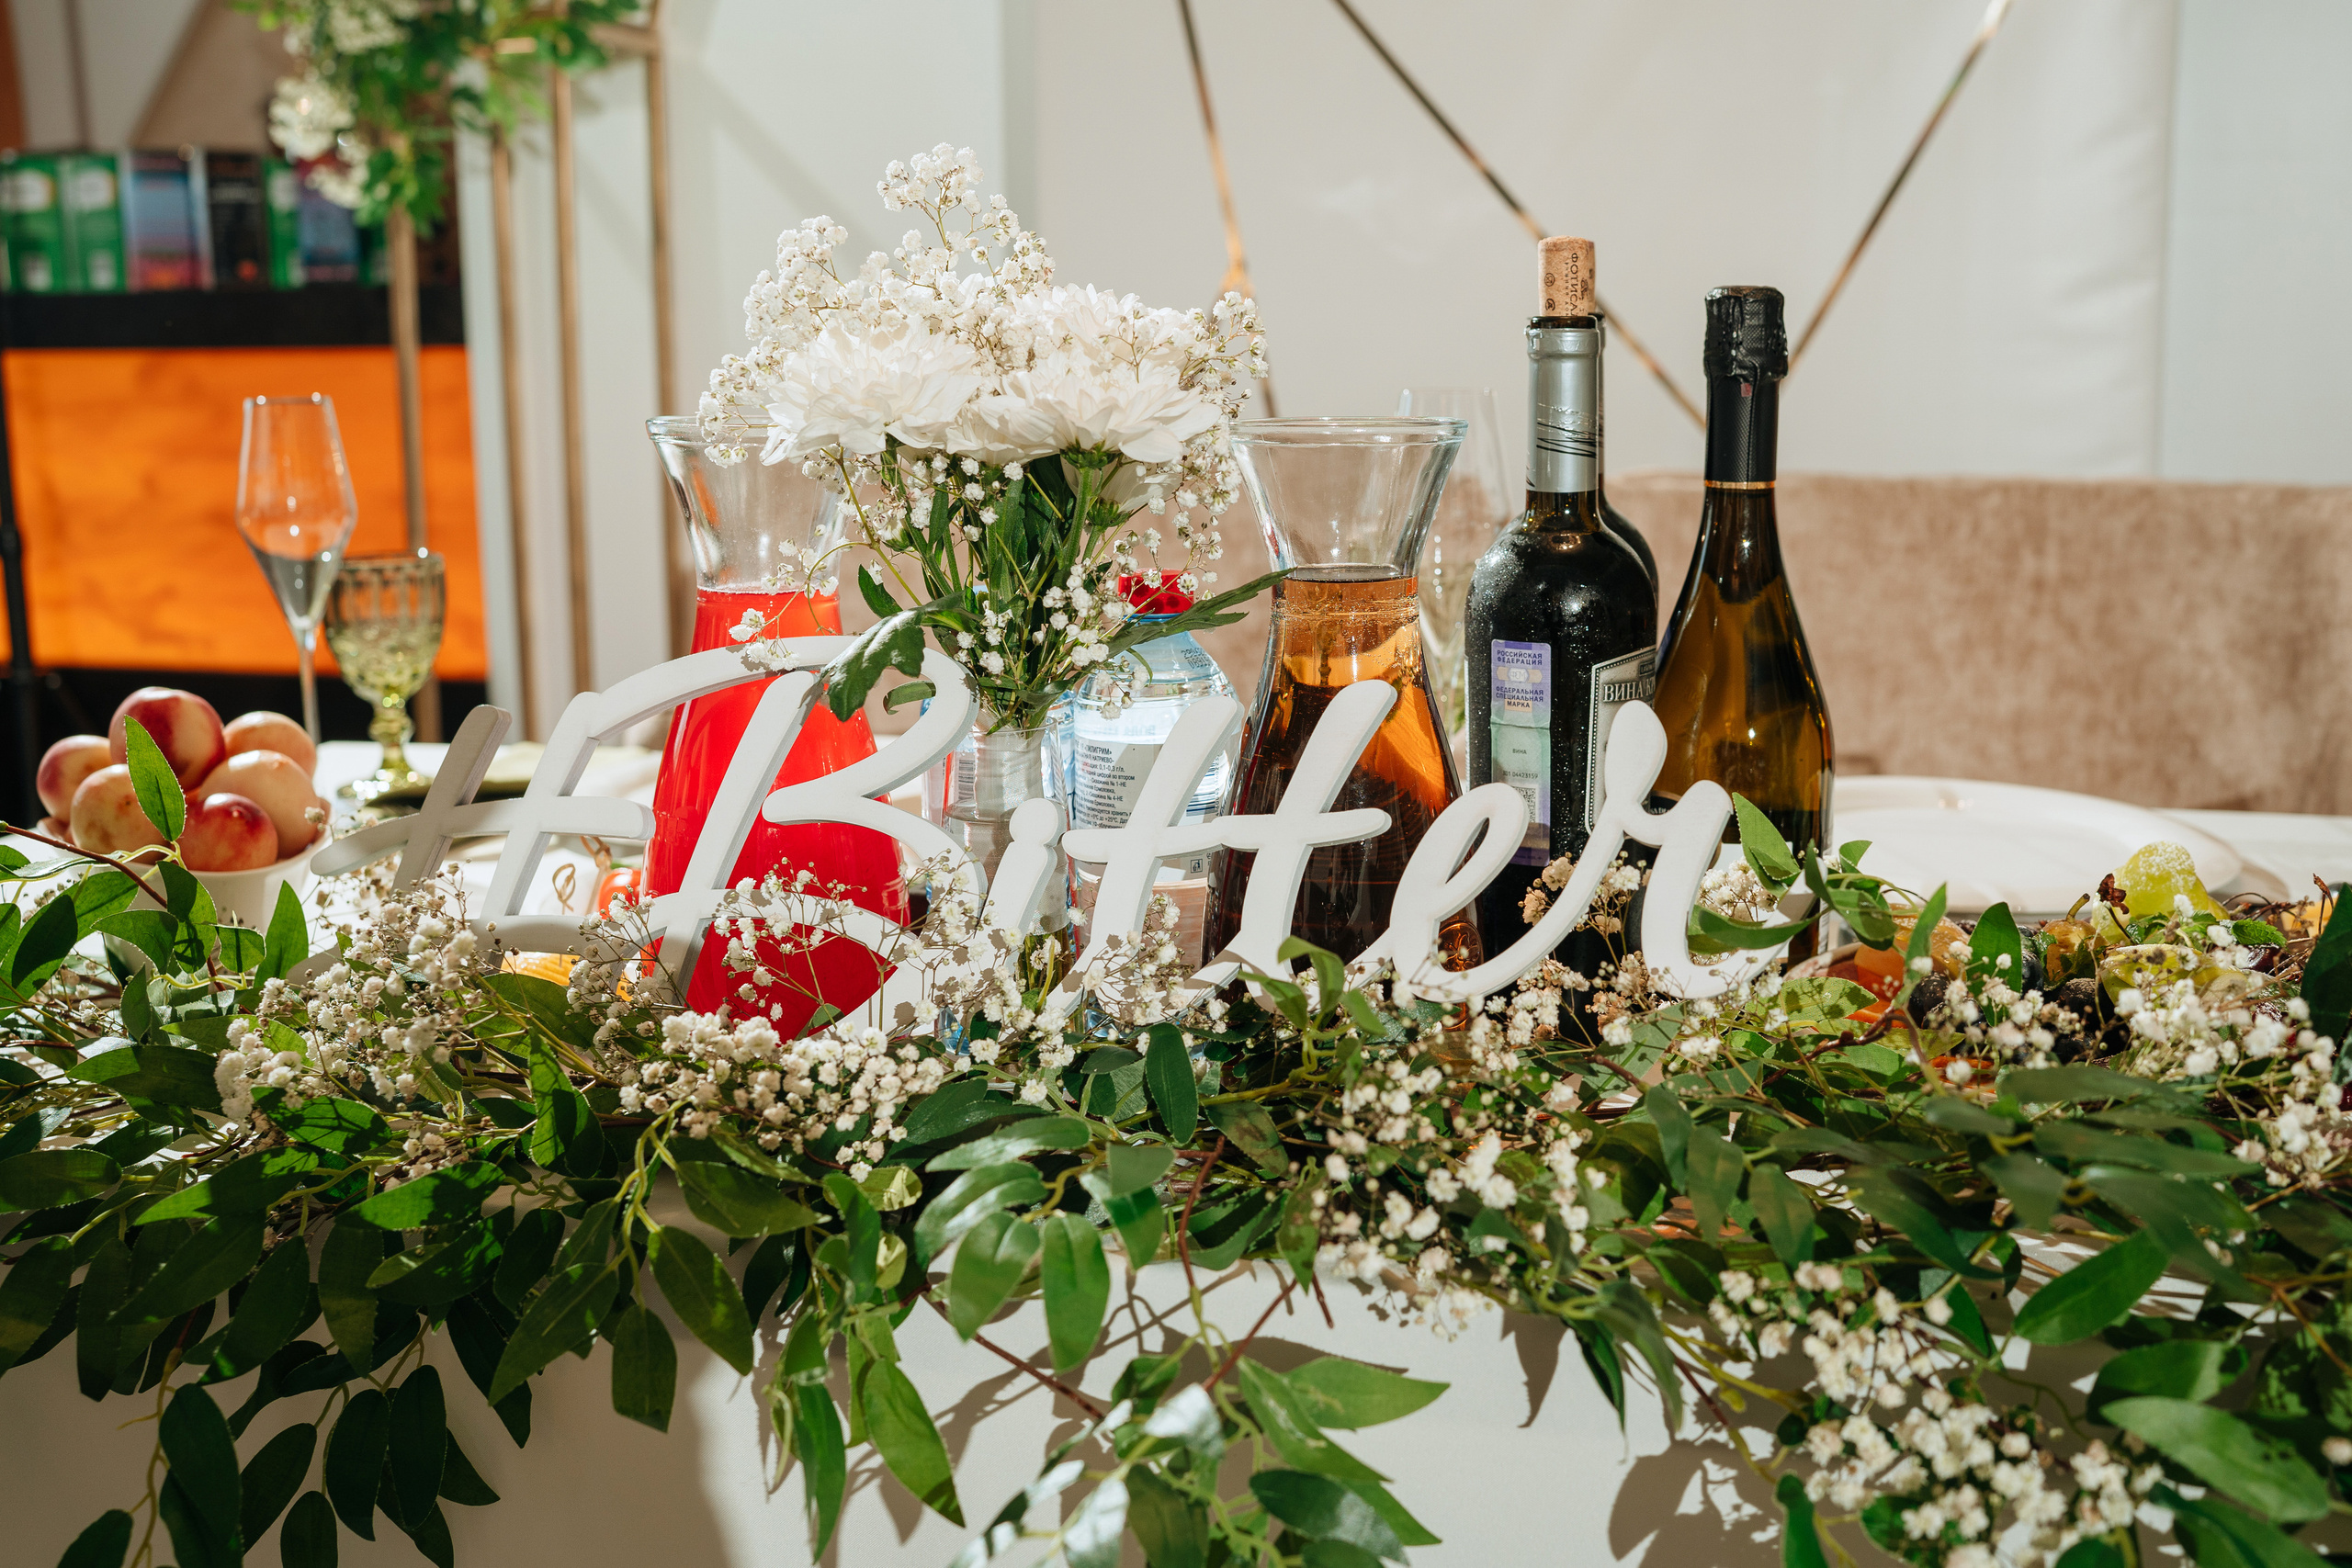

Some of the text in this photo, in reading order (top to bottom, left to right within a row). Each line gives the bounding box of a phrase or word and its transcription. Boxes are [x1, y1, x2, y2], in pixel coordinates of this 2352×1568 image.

[1497, 649, 1543, 659] РОССИЙСКАЯ
[1497, 657, 1543, 665] ФЕДЕРАЦИЯ
[1496, 686, 1544, 695] ФЕДЕРАЛЬНАЯ
[1602, 682, 1644, 702] ВИНА
[1496, 693, 1544, 702] СПЕЦИАЛЬНАЯ
[1507, 700, 1531, 708] МАРКА
